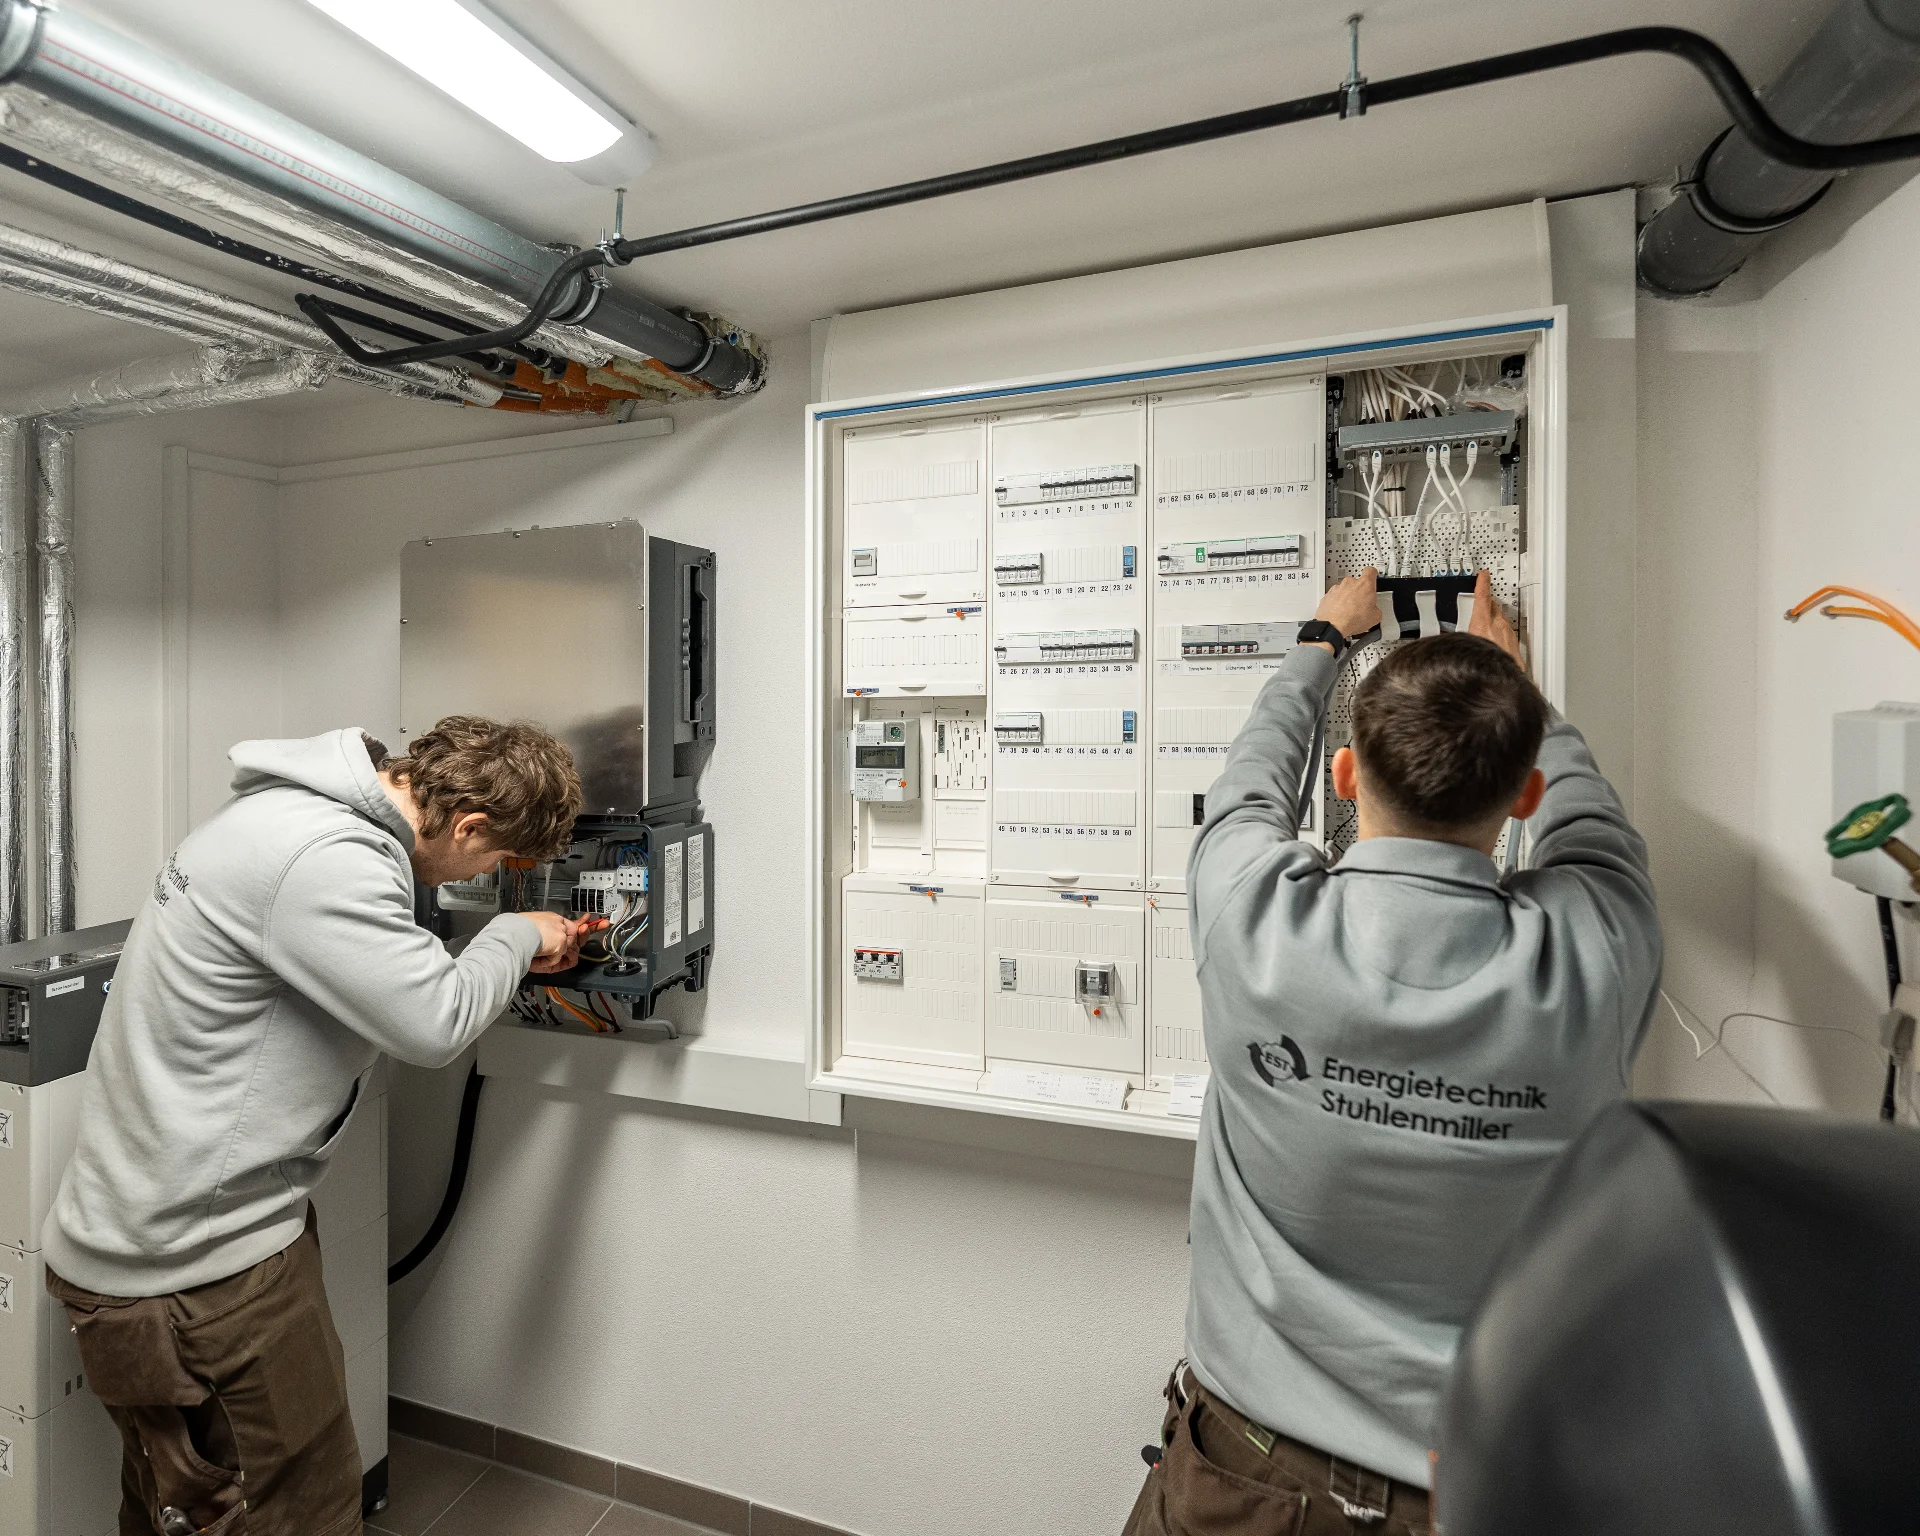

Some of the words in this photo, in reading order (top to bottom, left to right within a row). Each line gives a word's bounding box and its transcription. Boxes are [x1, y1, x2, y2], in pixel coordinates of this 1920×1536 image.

[1265, 1051, 1290, 1071] EST
[1322, 1057, 1548, 1110] Energietechnik
[1320, 1090, 1513, 1140] Stuhlenmiller
